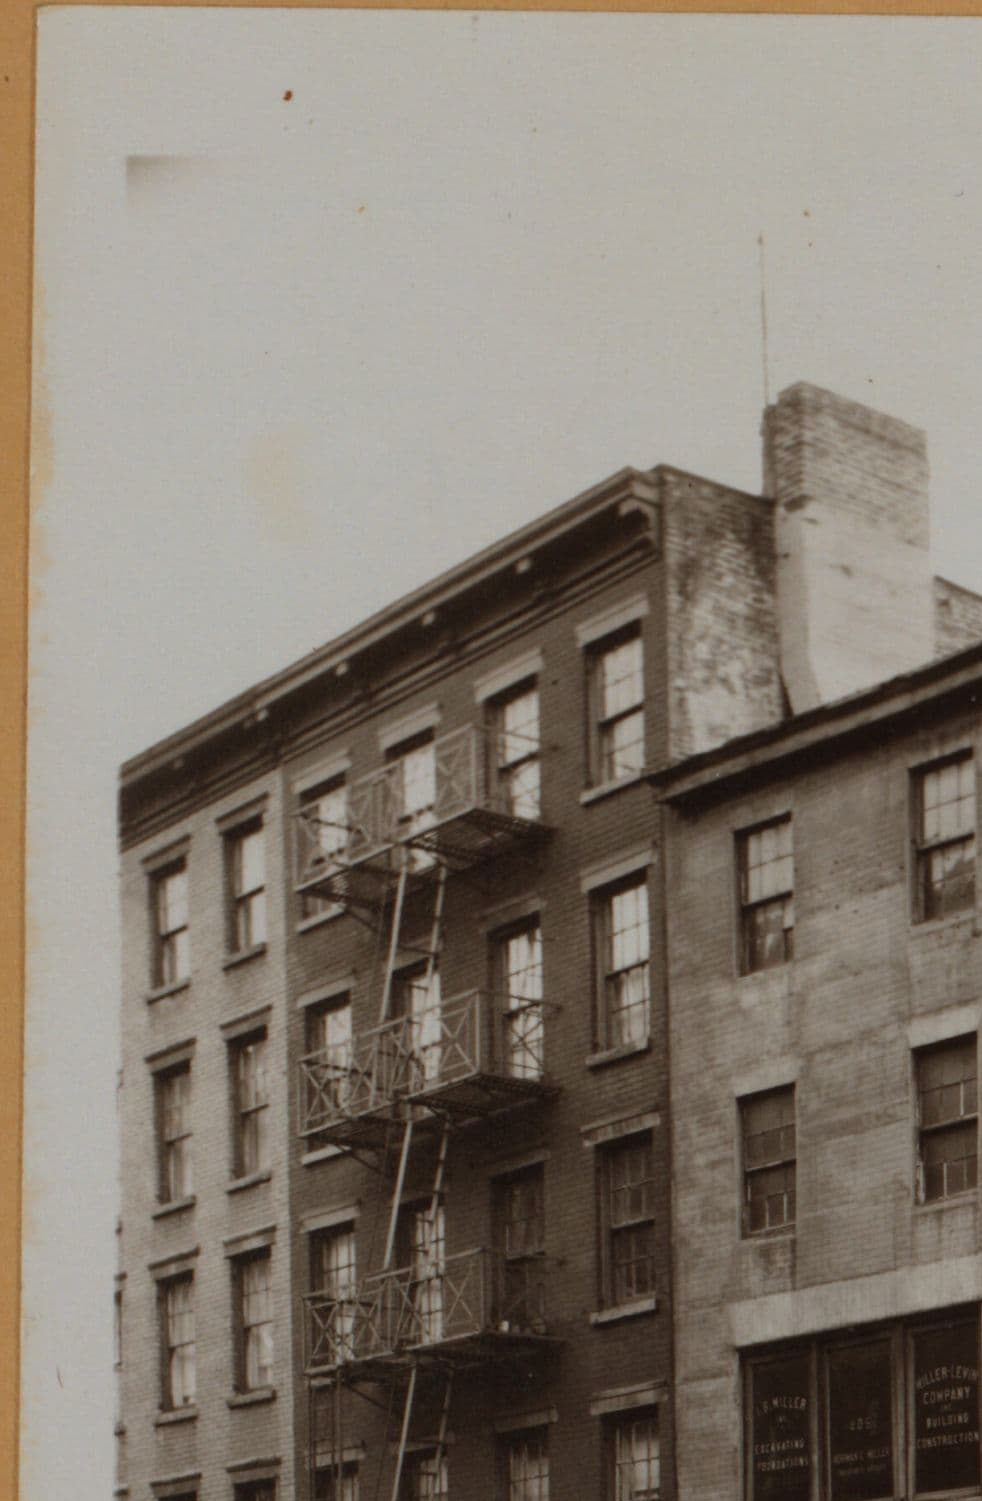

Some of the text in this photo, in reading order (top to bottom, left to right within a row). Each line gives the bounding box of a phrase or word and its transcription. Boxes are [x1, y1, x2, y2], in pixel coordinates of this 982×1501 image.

[923, 1386, 970, 1405] COMPANY
[926, 1412, 969, 1429] BUILDING
[917, 1431, 979, 1448] CONSTRUCTION
